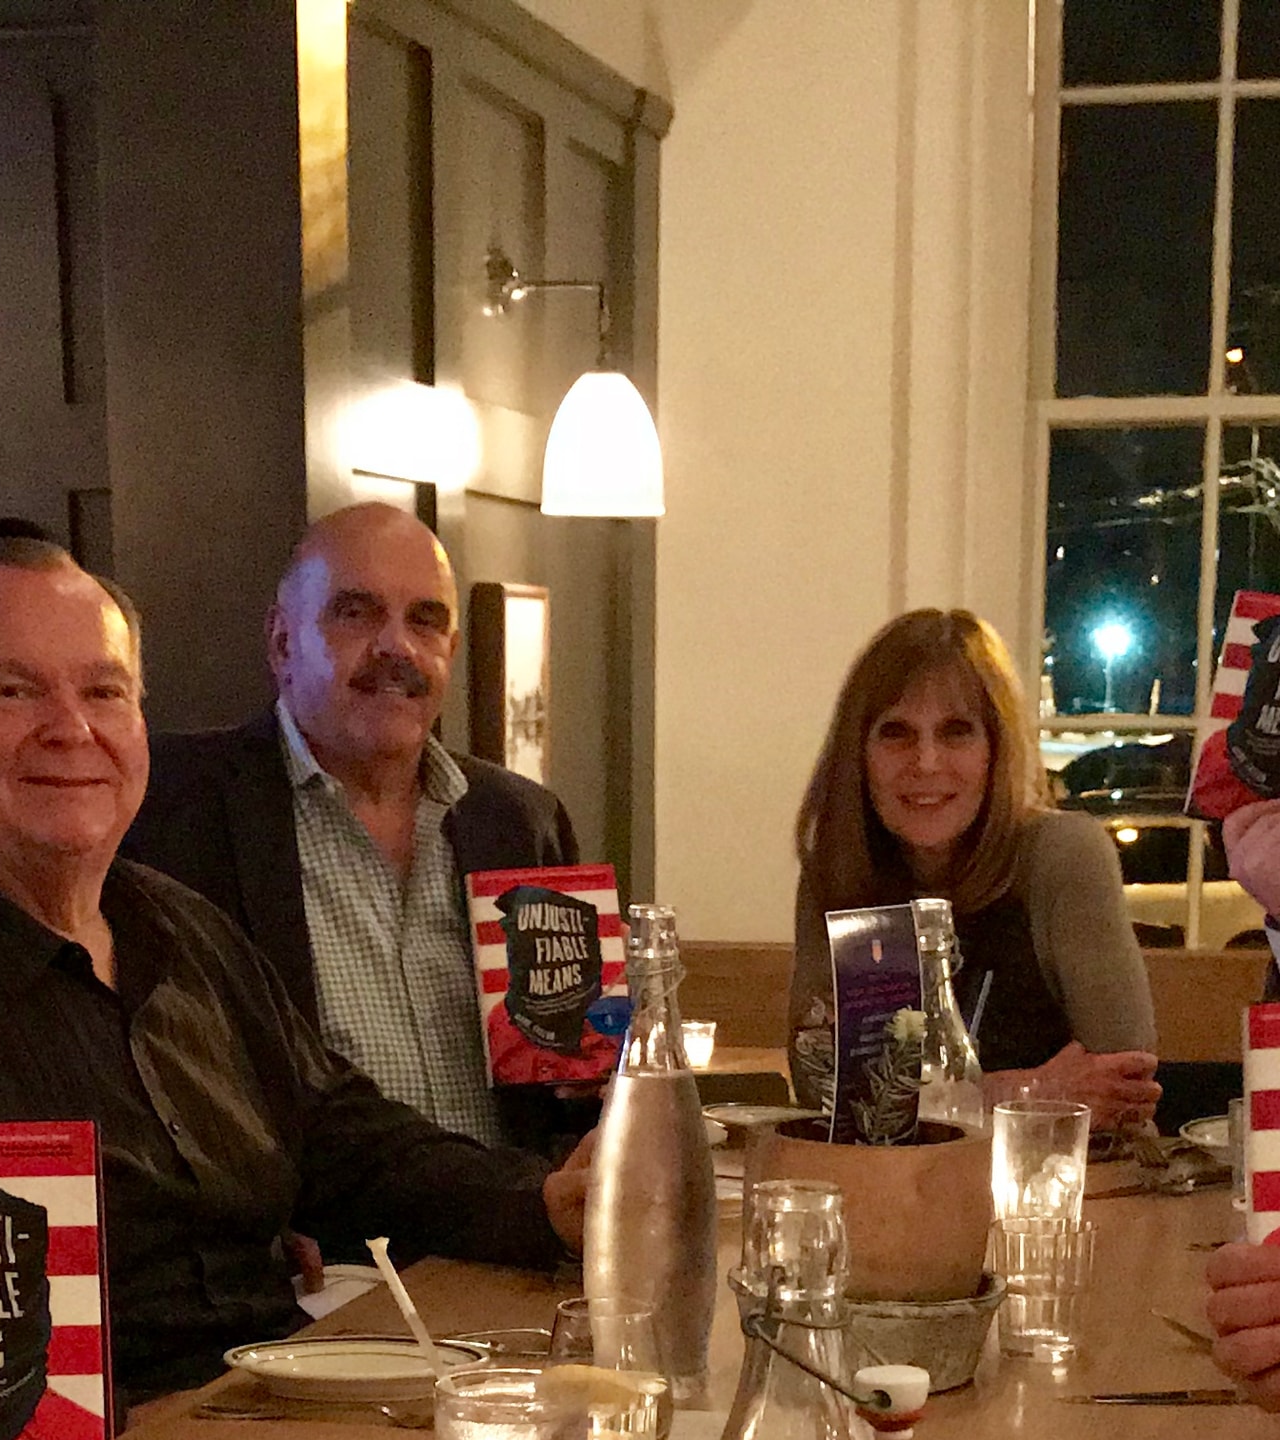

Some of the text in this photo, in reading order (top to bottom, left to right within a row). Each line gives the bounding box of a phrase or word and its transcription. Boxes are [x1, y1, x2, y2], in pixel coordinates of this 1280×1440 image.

[517, 903, 590, 933] UNJUSTI-
[535, 936, 589, 964] FIABLE
[529, 963, 582, 996] MEANS
